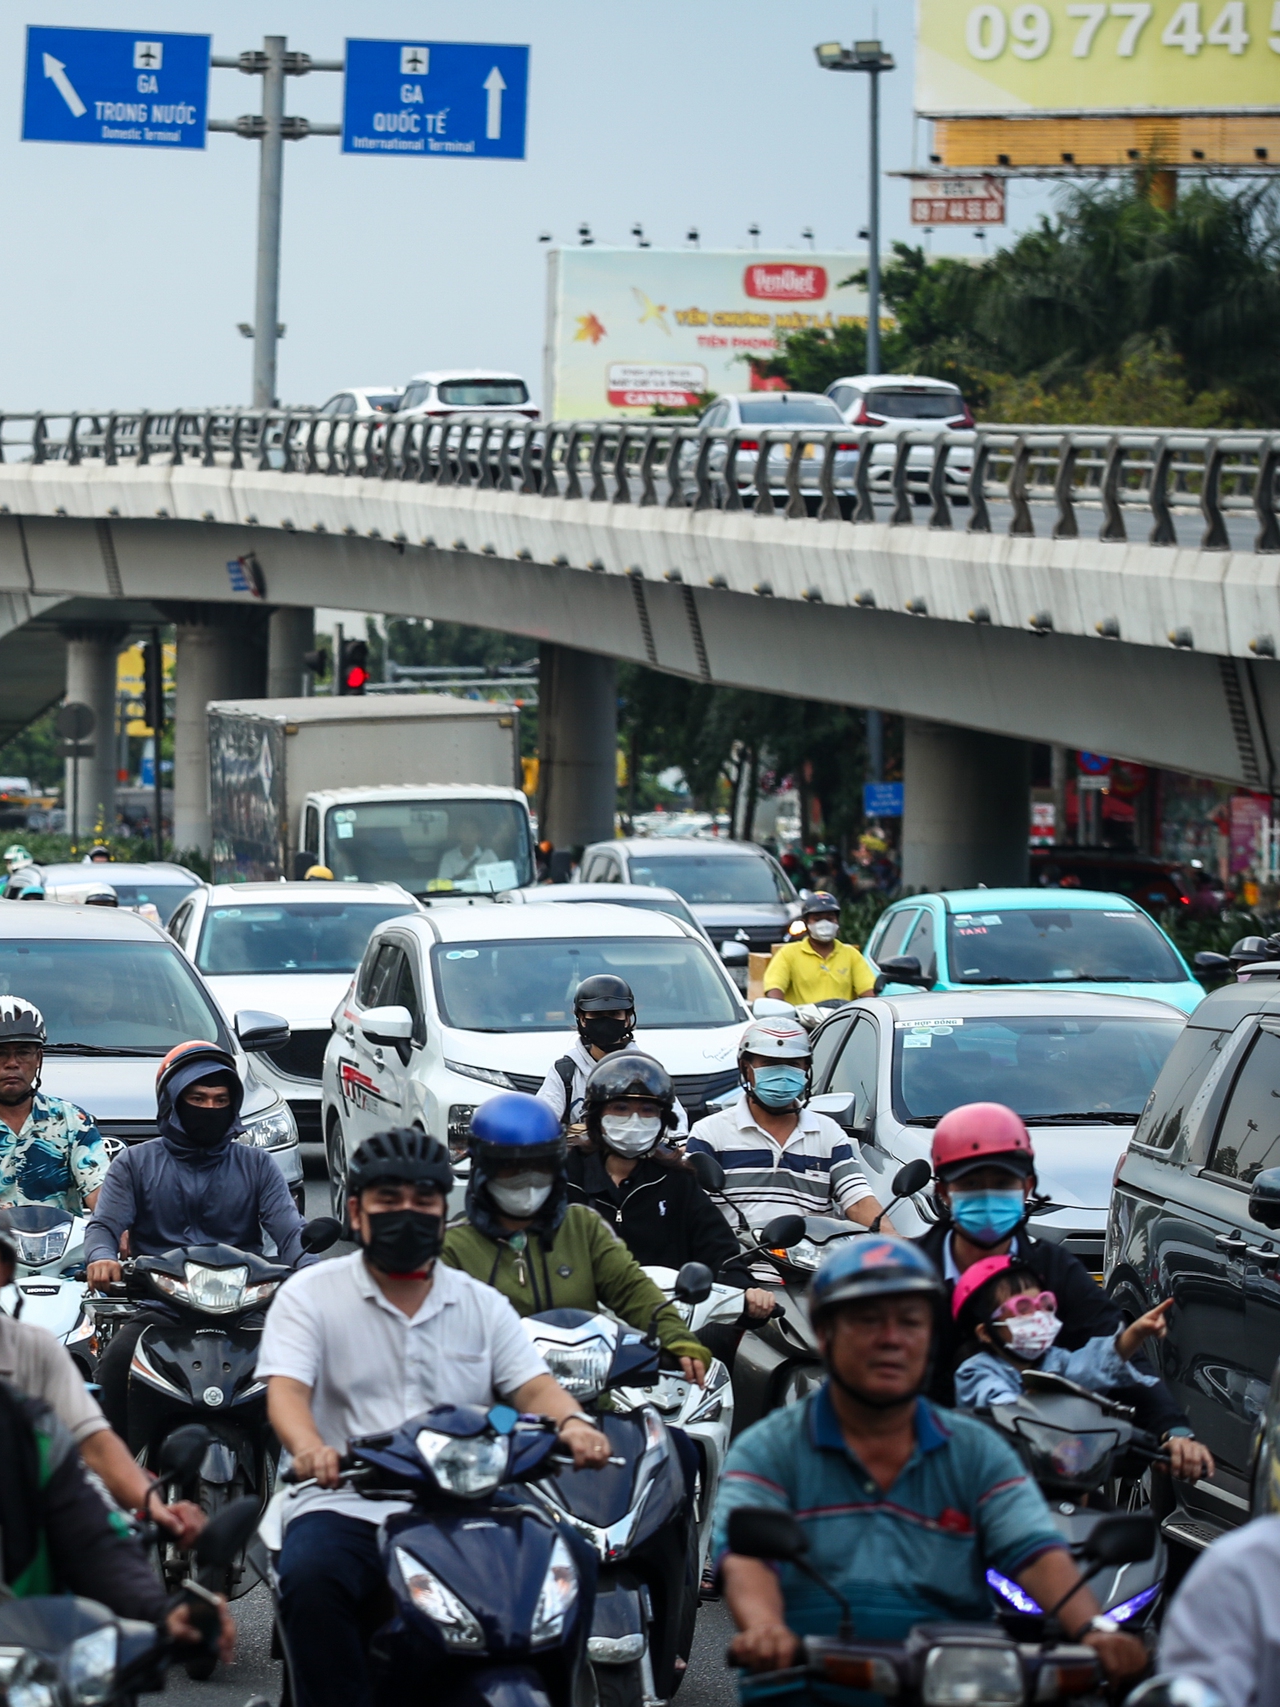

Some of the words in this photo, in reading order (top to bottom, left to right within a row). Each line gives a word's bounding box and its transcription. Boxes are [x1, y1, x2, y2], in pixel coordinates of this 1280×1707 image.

[966, 3, 1051, 61] 09
[1066, 3, 1151, 58] 77
[1161, 2, 1249, 55] 44
[136, 74, 158, 94] GA
[401, 84, 424, 104] GA
[94, 101, 148, 122] TRONG
[151, 101, 196, 125] NƯỚC
[373, 107, 421, 133] QUỐC
[425, 107, 451, 134] TẾ
[101, 125, 142, 140] Domestic
[144, 127, 181, 142] Terminal
[352, 136, 425, 151] International
[428, 138, 476, 153] Terminal
[959, 926, 988, 936] TAXI
